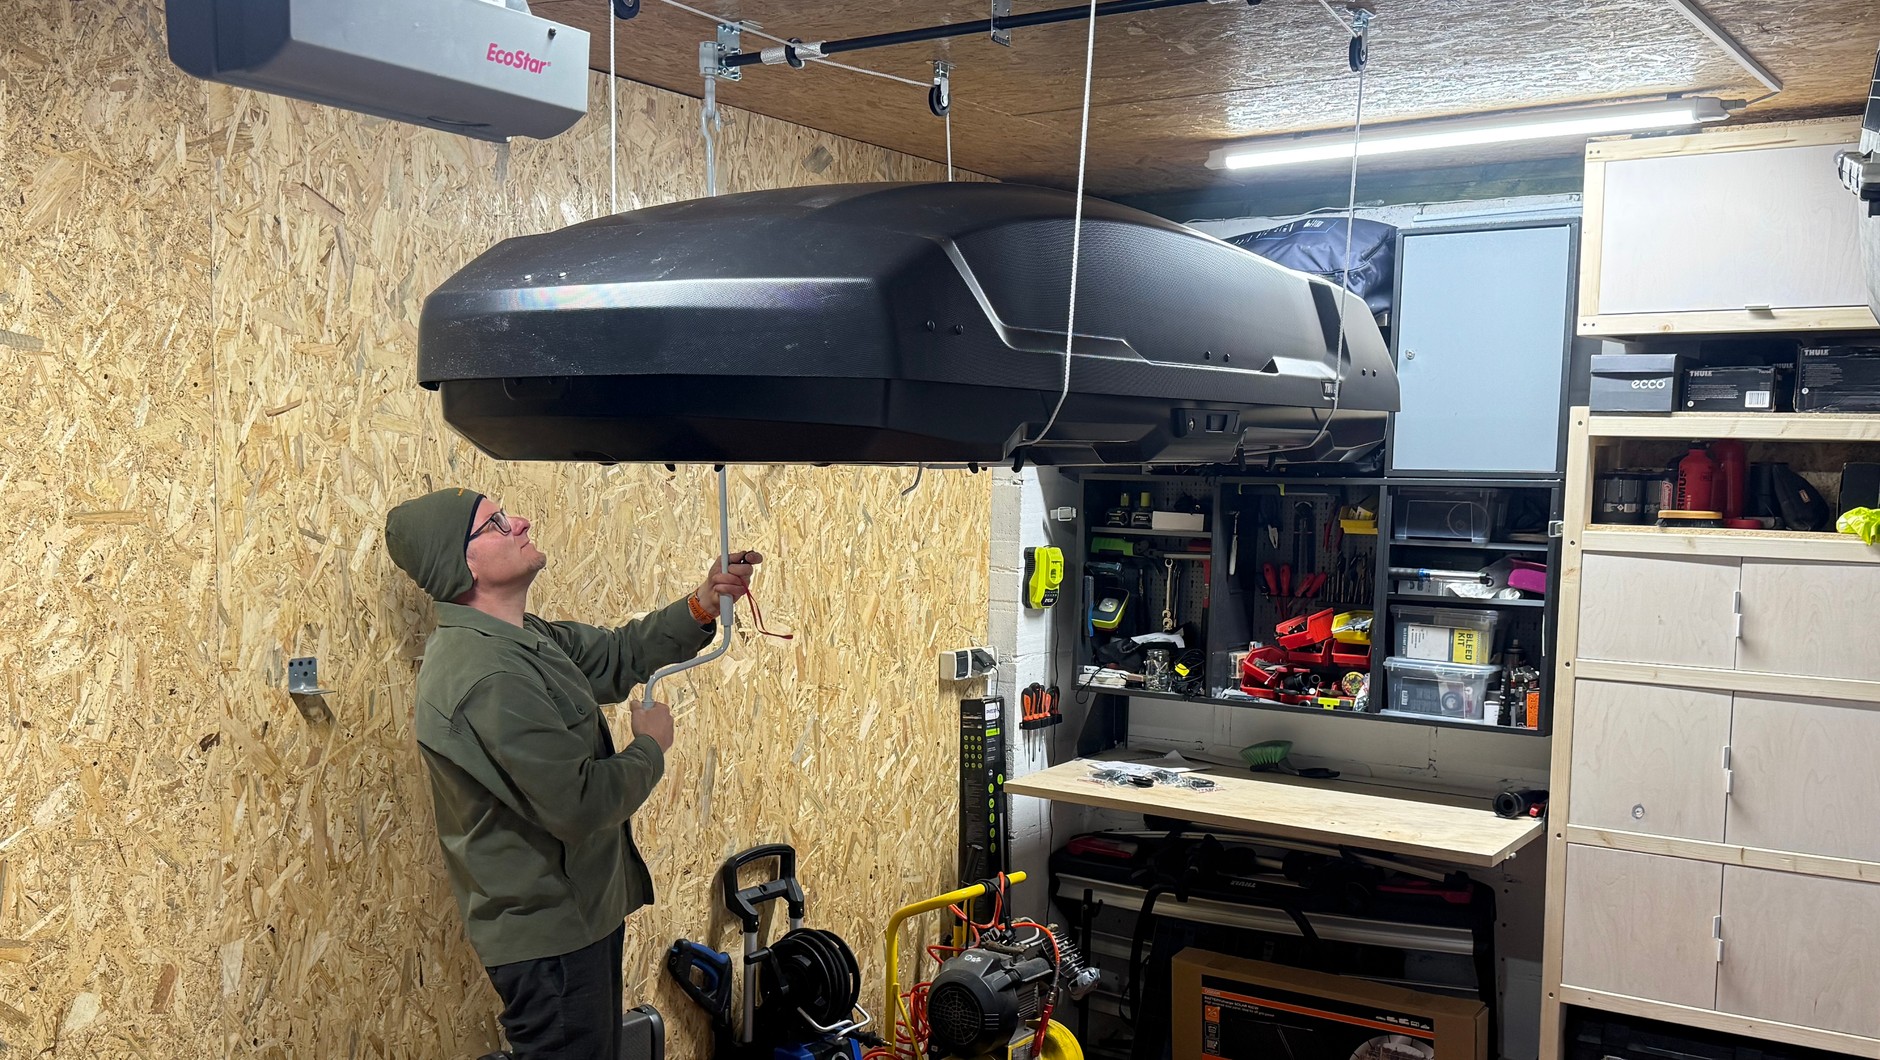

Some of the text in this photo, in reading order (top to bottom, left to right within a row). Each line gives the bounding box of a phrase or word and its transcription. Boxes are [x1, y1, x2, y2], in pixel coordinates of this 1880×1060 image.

[487, 43, 547, 74] EcoStar
[1631, 379, 1665, 389] ecco
[1677, 469, 1687, 510] RIMUS
[1458, 632, 1466, 647] KIT
[1465, 633, 1473, 660] BLEED
